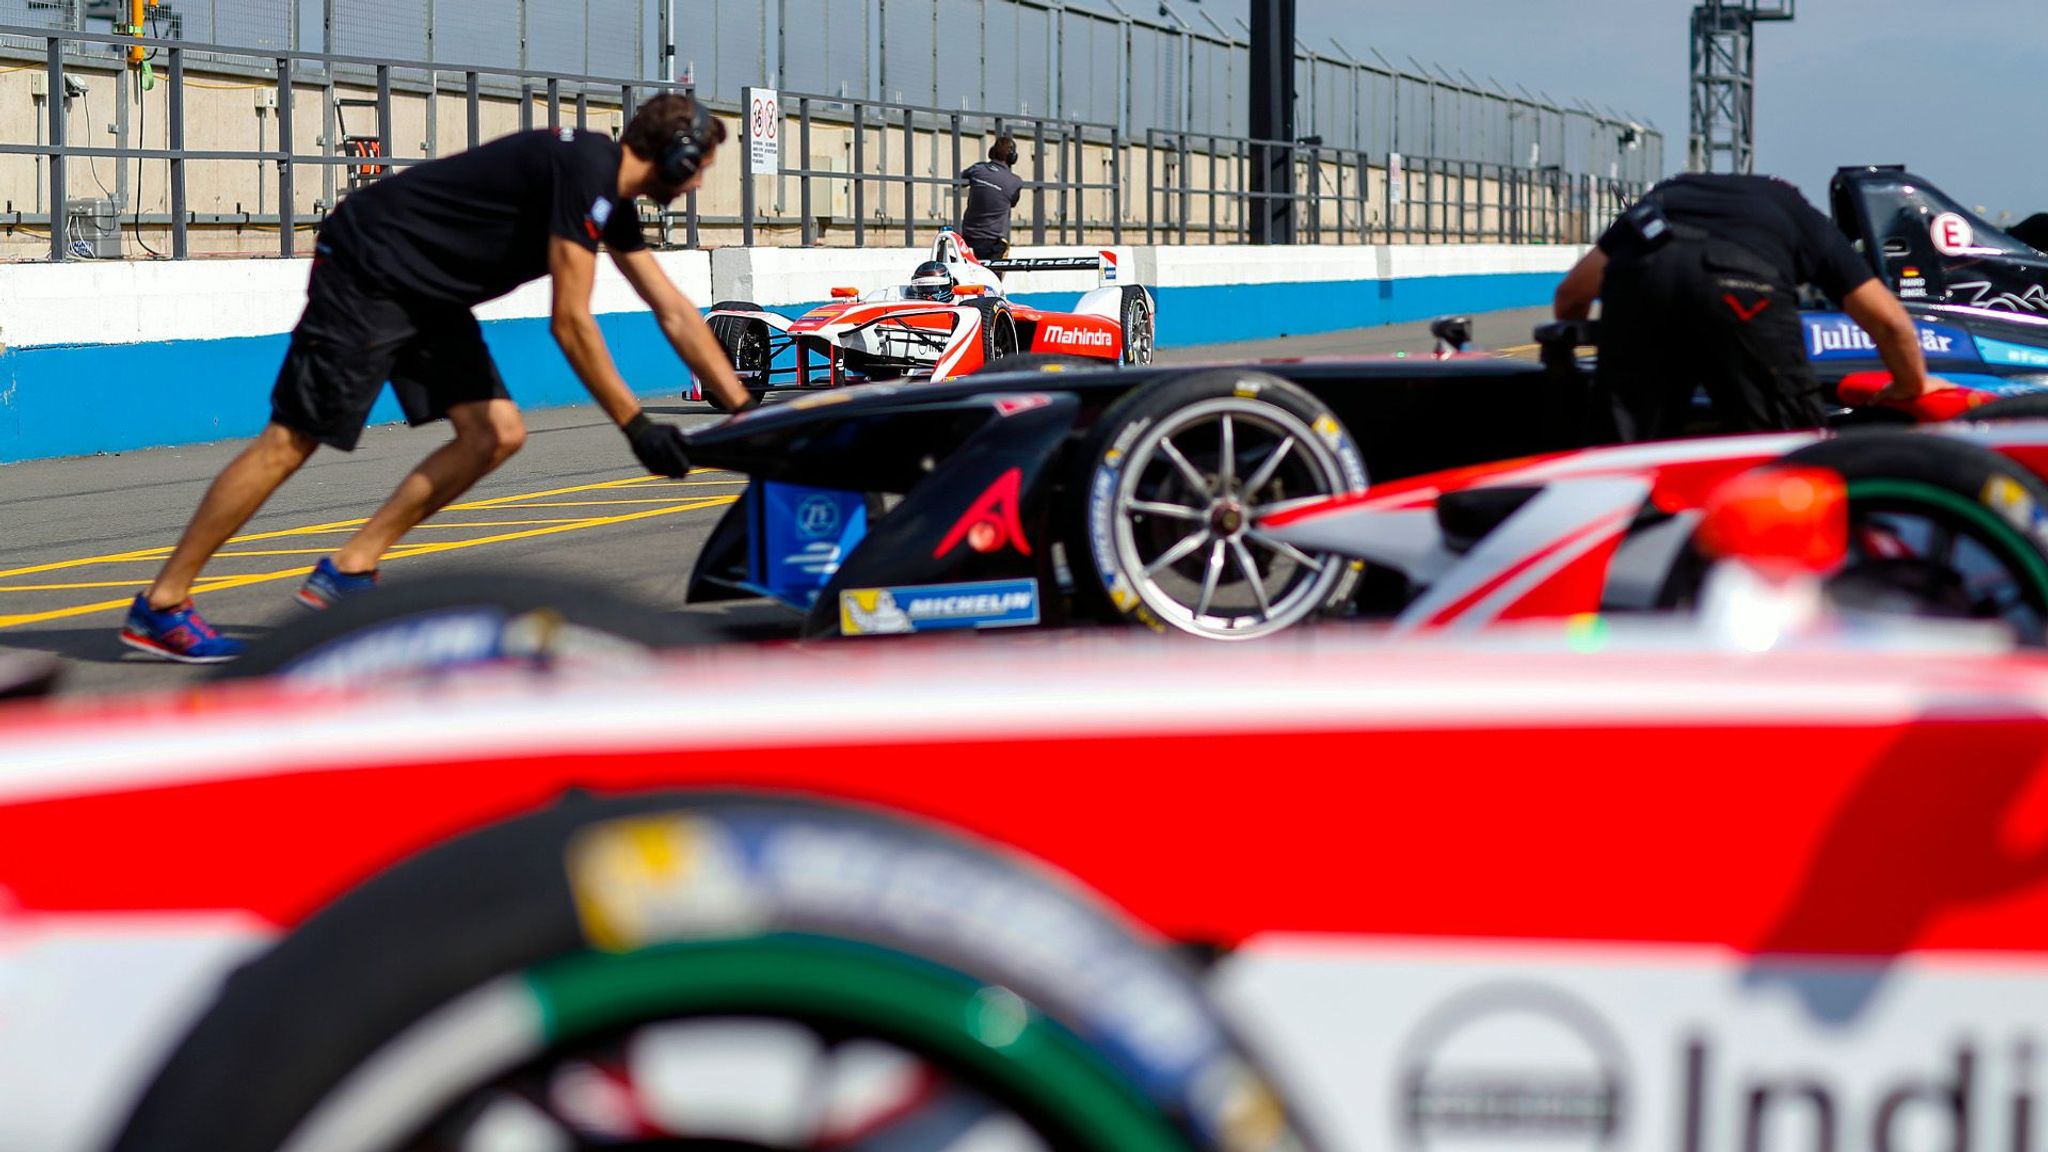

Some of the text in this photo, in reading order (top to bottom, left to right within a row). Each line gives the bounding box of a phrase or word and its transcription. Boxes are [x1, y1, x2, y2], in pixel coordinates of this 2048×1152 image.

[1944, 221, 1961, 248] E
[1043, 325, 1113, 346] Mahindra
[1811, 322, 1953, 356] Juliu är
